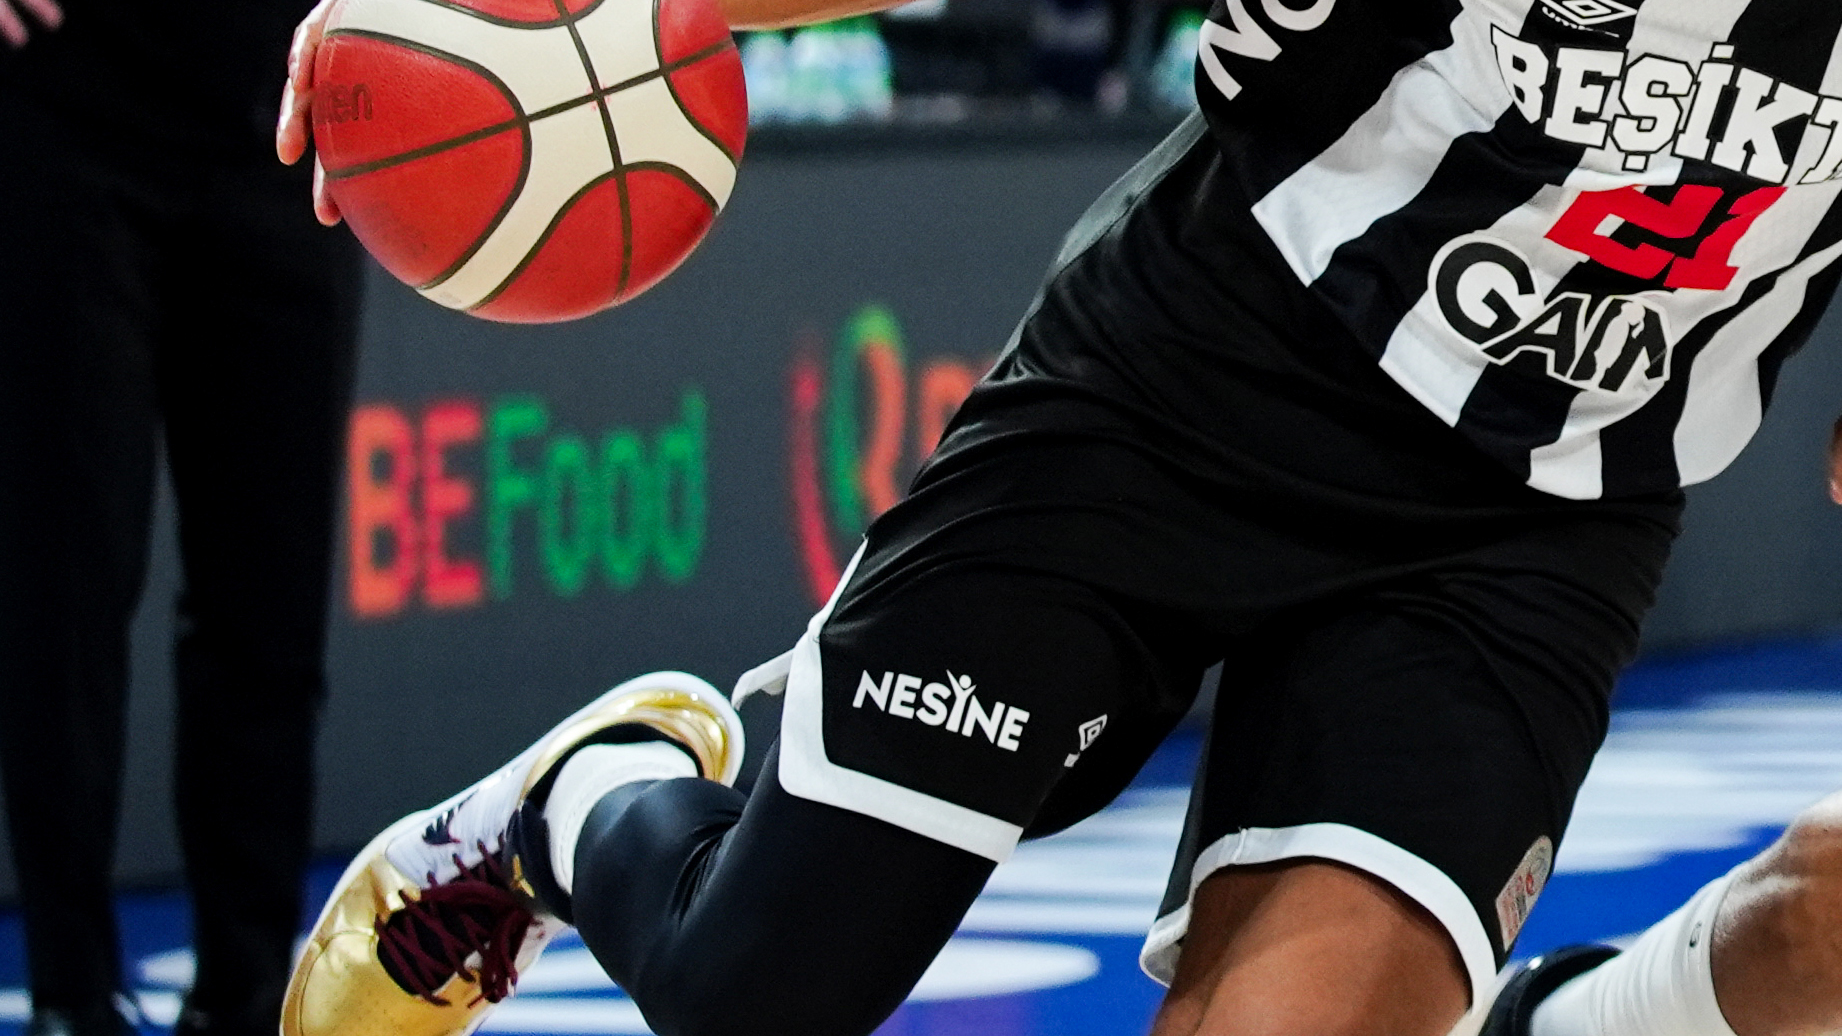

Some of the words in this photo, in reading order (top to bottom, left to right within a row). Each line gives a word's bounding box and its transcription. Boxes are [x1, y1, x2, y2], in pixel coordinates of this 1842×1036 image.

[1430, 232, 1671, 392] GAIN
[1545, 184, 1788, 291] 21
[349, 385, 706, 616] BEFood
